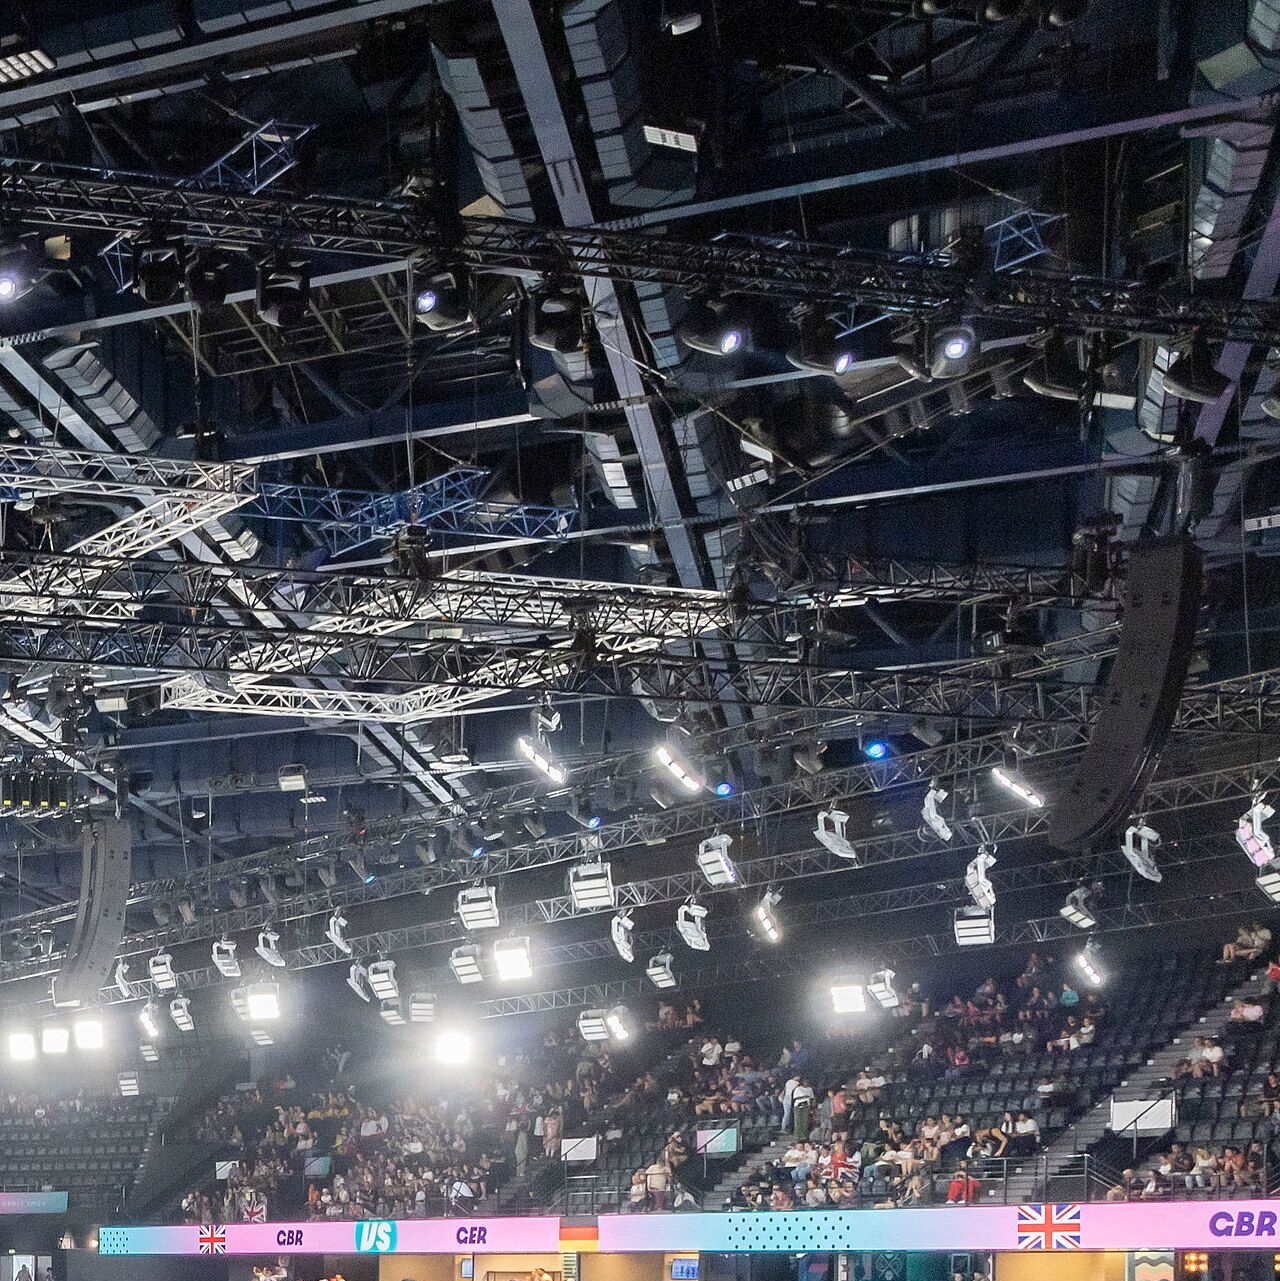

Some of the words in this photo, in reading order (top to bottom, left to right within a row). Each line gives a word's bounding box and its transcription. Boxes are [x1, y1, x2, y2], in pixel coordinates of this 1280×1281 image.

[277, 1229, 303, 1246] GBR
[359, 1223, 391, 1250] VS
[456, 1226, 487, 1245] GER
[1209, 1211, 1277, 1237] GBR
